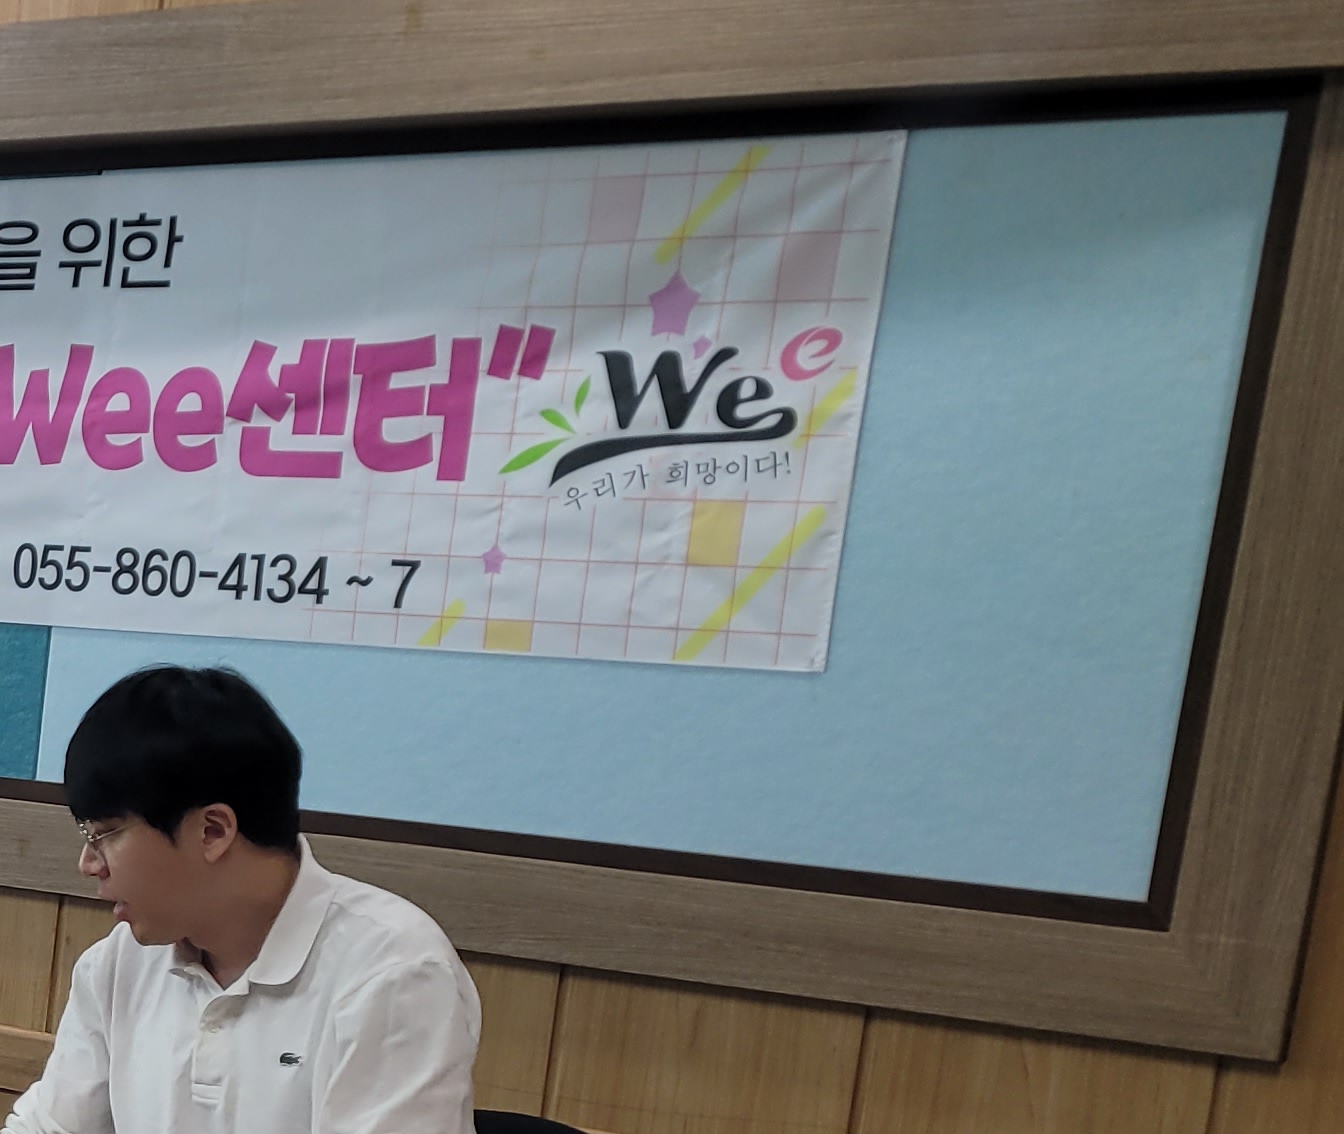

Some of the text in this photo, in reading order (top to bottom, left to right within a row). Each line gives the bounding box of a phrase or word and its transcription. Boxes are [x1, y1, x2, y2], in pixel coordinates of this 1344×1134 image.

[57, 211, 185, 290] 위한
[563, 450, 792, 511] 우리가 희망이다!
[11, 541, 331, 606] 055-860-4134
